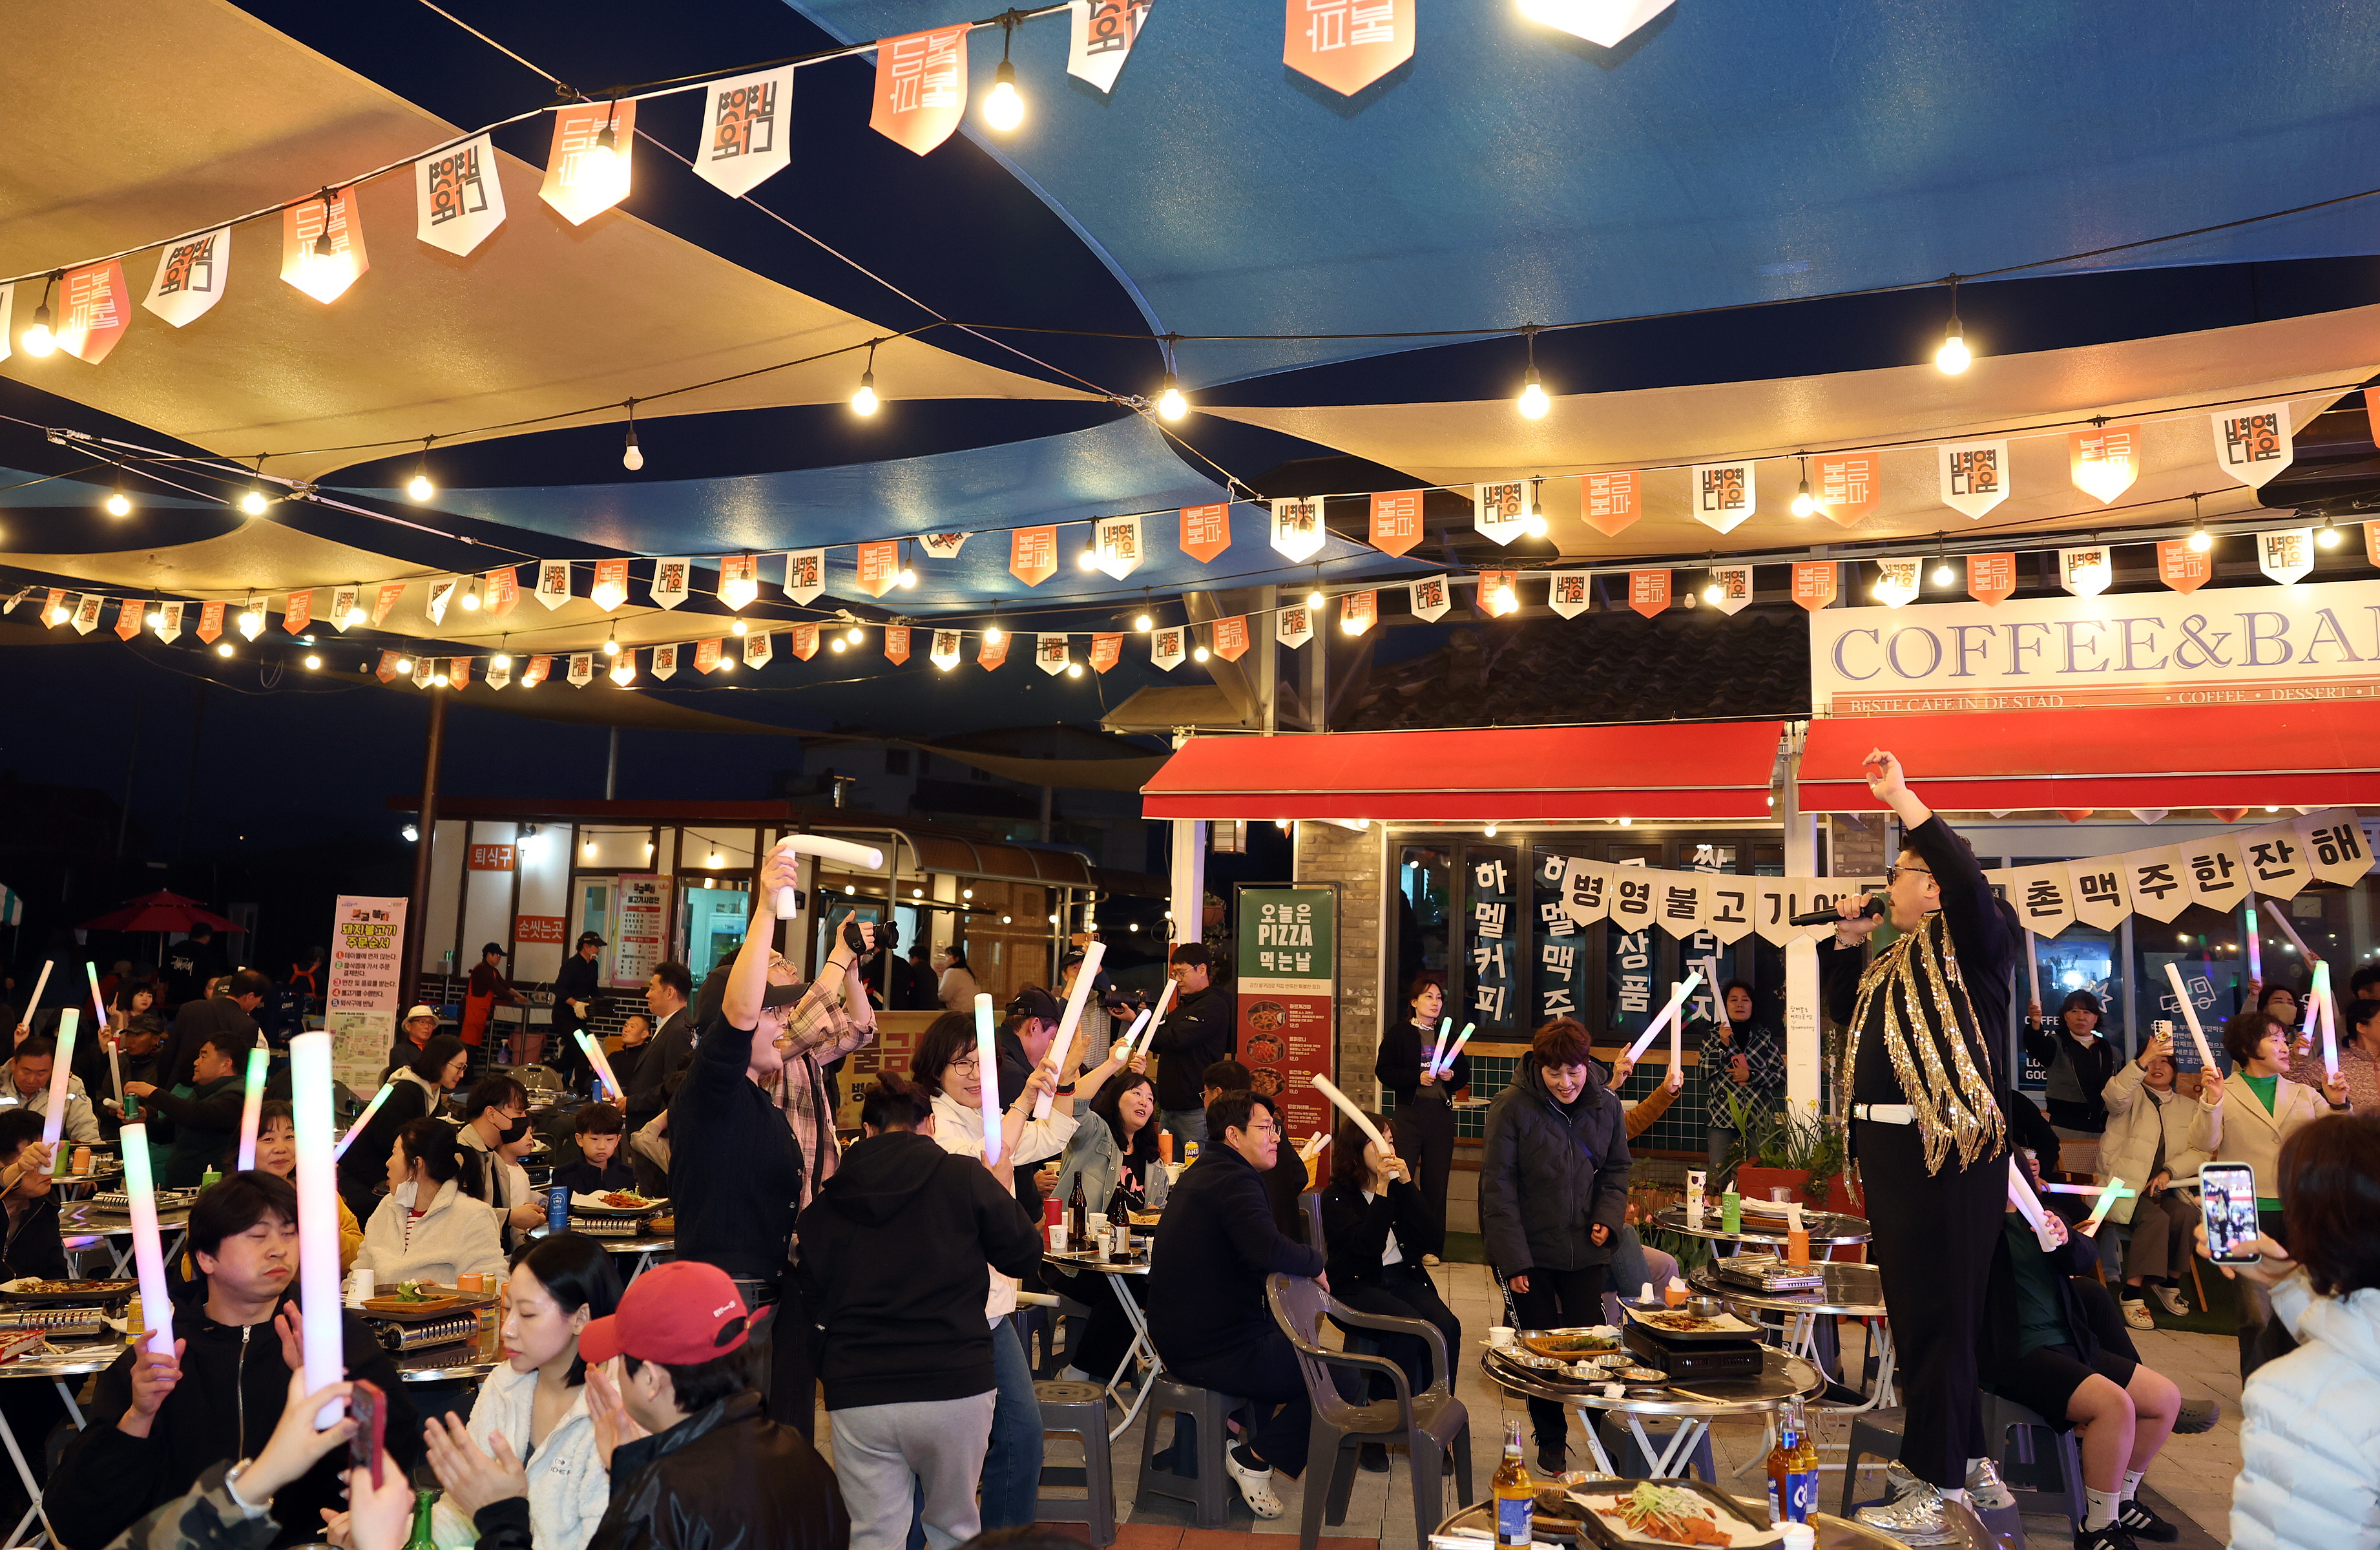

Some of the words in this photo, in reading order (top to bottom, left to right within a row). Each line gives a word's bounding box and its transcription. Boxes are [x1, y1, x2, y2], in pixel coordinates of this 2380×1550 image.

[2179, 690, 2246, 702] COFFEE
[2272, 687, 2350, 699] DESSERT
[475, 848, 512, 867] 퇴식구
[1261, 904, 1311, 924] 오늘은
[341, 923, 397, 937] 돼지불고기
[1258, 925, 1313, 947] PIZZA
[346, 936, 390, 948] 주문순서
[1474, 859, 1508, 1021] 하멜커피
